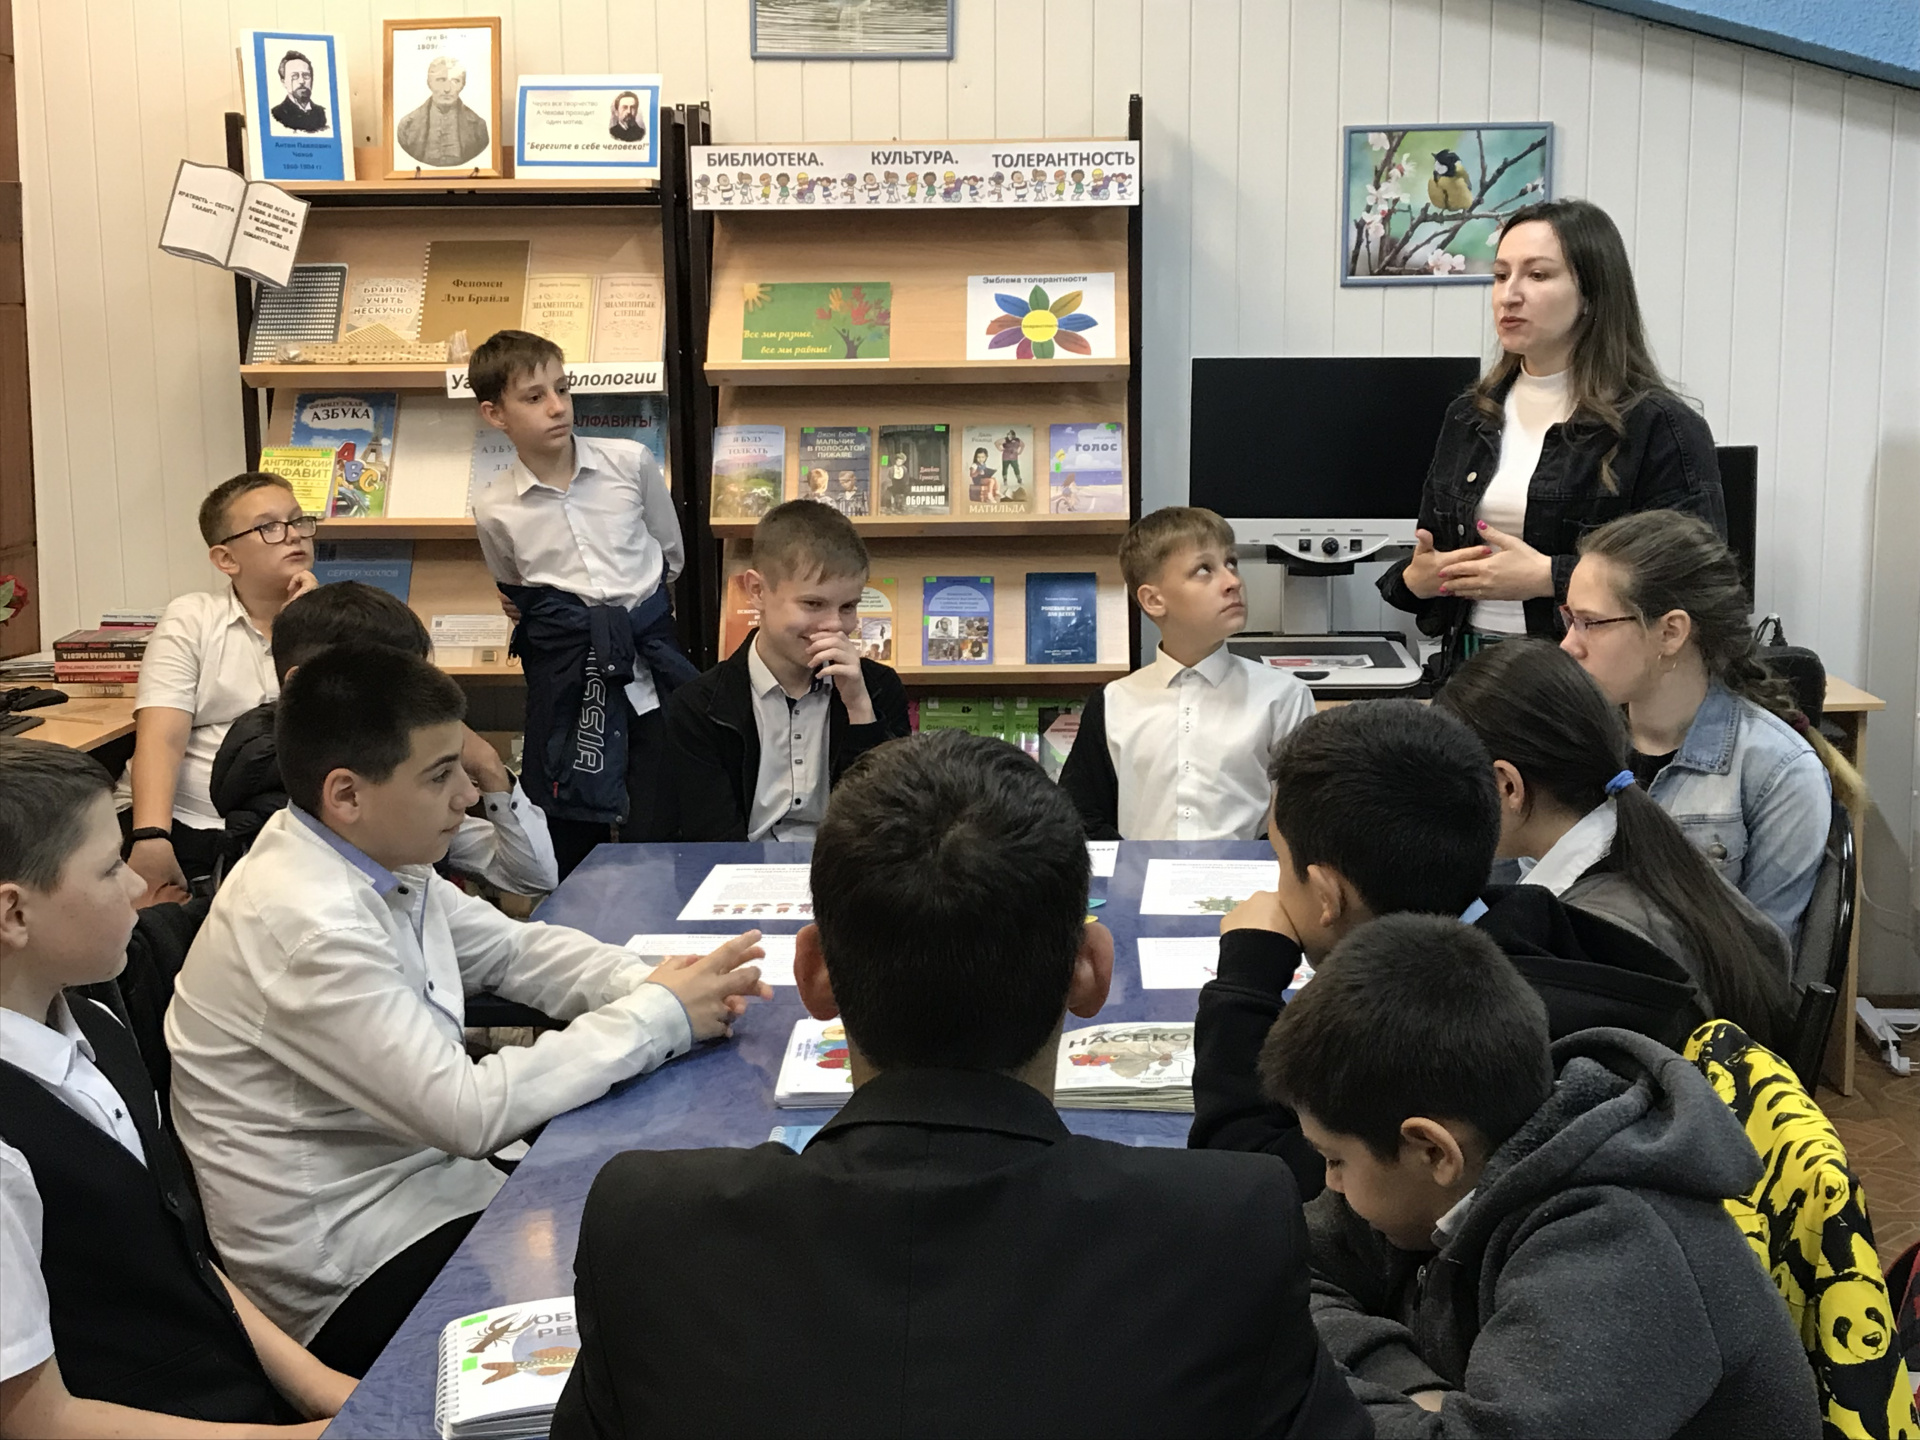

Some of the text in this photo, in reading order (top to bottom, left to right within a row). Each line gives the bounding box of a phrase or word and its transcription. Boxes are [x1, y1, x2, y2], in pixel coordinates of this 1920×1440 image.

[581, 142, 601, 150] себе
[706, 150, 1136, 169] БИБЛИОТЕКА. КУЛЬТУРА. ТОЛЕРАНТНОСТЬ
[178, 190, 209, 205] КРАТКОСТЬ
[214, 201, 236, 213] СЕСТРА
[452, 278, 504, 288] Феномен
[982, 275, 1088, 285] Эмблема толерантности
[363, 286, 407, 294] БРАЙЛЬ
[441, 293, 510, 304] Луи Брайля
[531, 301, 585, 309] ЗНАМЕНИТЫЕ
[604, 301, 657, 309] ЗНАМЕНИТЫЕ
[353, 307, 413, 316] НЕСКУЧНО
[542, 310, 574, 318] СЛЕПЫЕ
[614, 309, 646, 317] СЛЕПЫЕ
[743, 330, 760, 339] Все
[778, 331, 814, 341] разные,
[760, 345, 776, 354] все
[794, 345, 833, 356] равные!
[566, 370, 657, 391] флологии
[308, 401, 363, 410] ФРАНЦУЗСКАЯ
[311, 408, 371, 422] АЗБУКА
[481, 445, 513, 454] АЗБУ
[728, 447, 768, 455] ТОЛКАТЬ
[815, 444, 865, 452] ПОЛОСАТОЙ
[262, 459, 332, 468] АНГЛИЙСКИЙ
[263, 467, 331, 479] АЛФАВИТ
[911, 484, 945, 492] МАЛЕНЬКИЙ
[905, 496, 946, 506] ОБОРВЫШ
[969, 504, 1026, 514] МАТИЛЬДА
[326, 569, 399, 577] СЕРГЕЙ ХОХЛОВ
[1068, 1033, 1192, 1049] НАСЕКО
